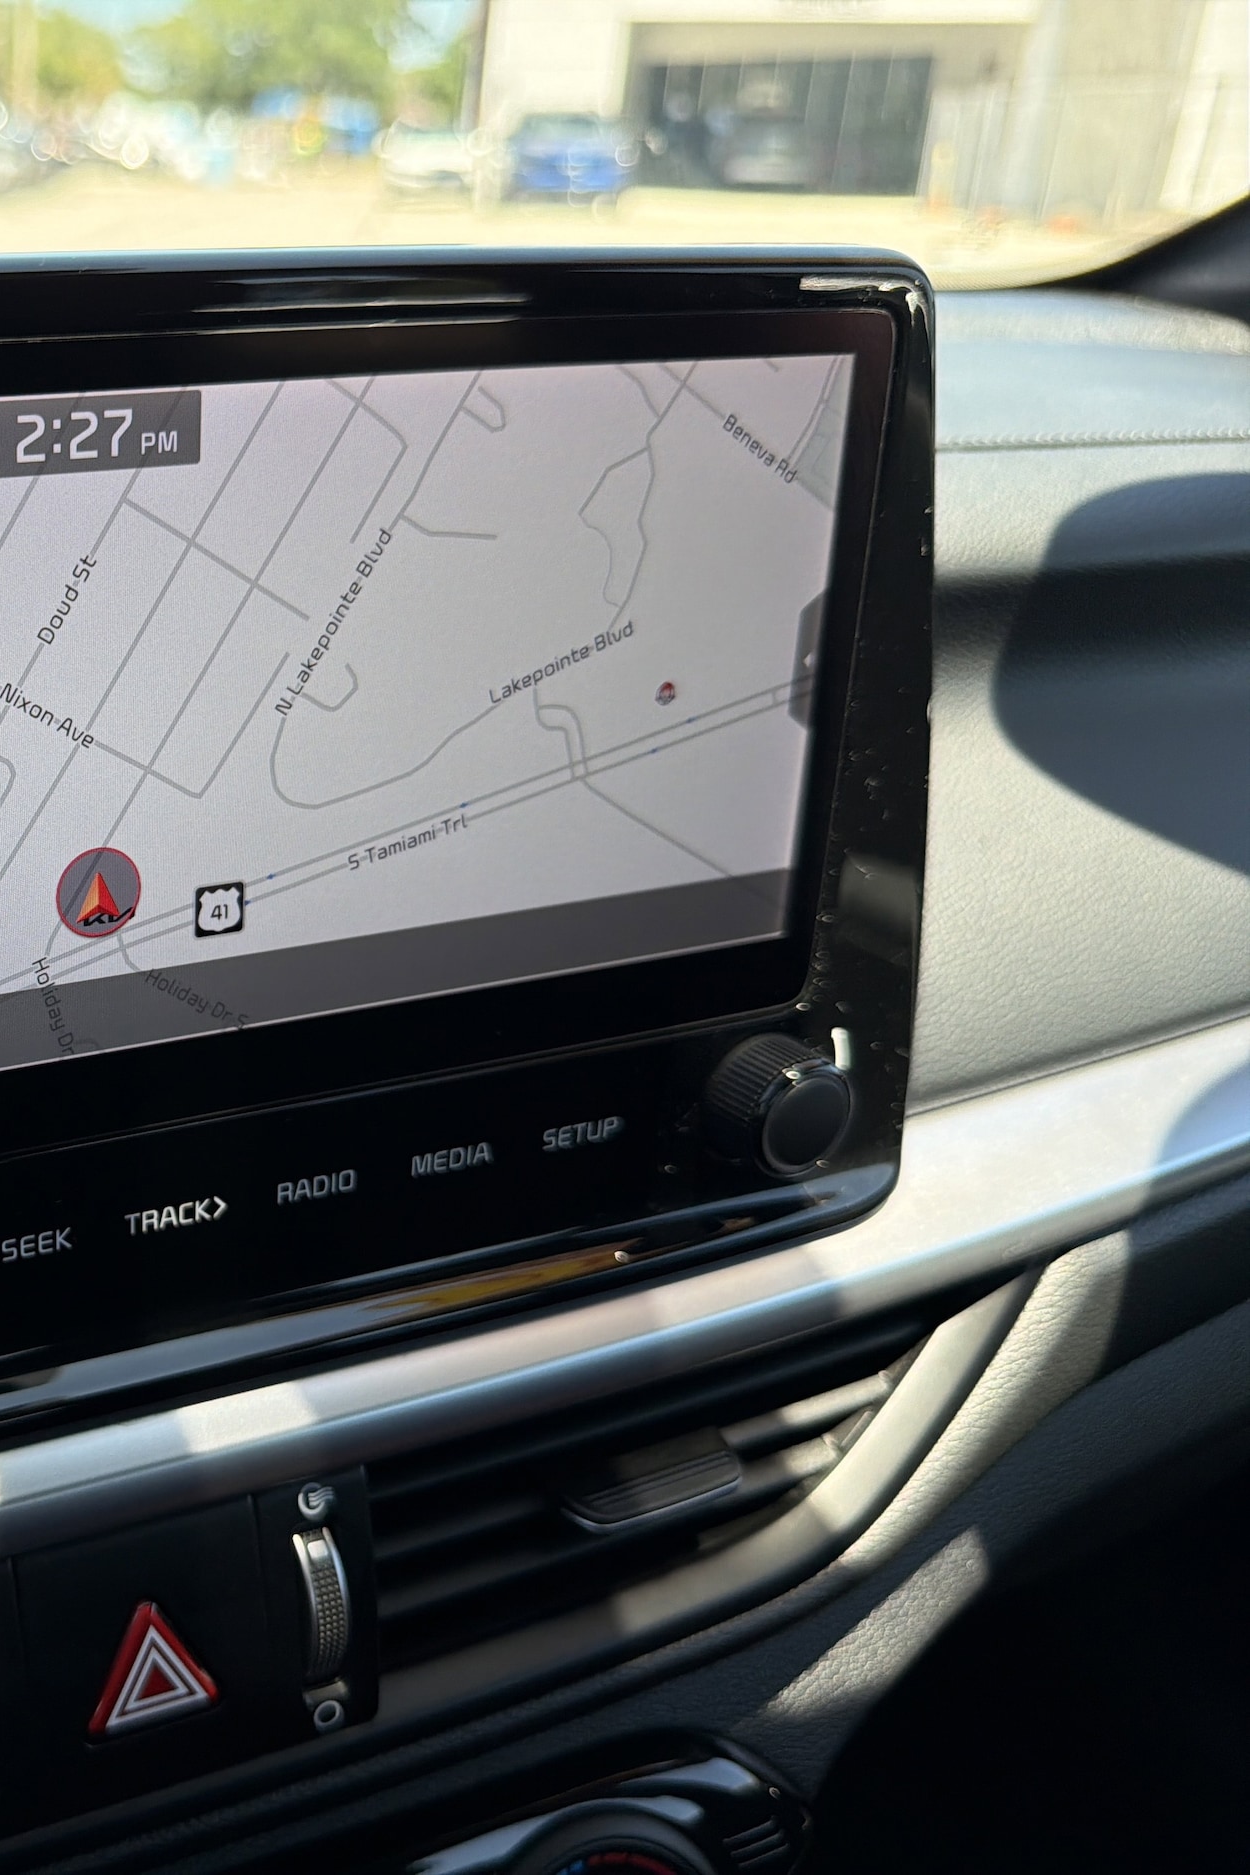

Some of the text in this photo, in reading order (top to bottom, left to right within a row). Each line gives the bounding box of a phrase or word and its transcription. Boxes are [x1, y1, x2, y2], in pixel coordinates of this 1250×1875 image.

[16, 409, 178, 464] 2:27 PM
[723, 414, 798, 484] Beneva Rd
[36, 555, 97, 645] Doud St
[274, 527, 392, 716] N Lakepointe Blvd
[488, 621, 635, 704] Lakepointe Blvd
[0, 682, 95, 749] Nixon Ave
[347, 814, 469, 871] S Tamiami Trl
[210, 903, 229, 921] 41
[32, 956, 75, 1055] Holiday Dr
[145, 968, 209, 1014] Holiday
[211, 1001, 234, 1020] Dr
[410, 1142, 494, 1179] MEDIA
[543, 1115, 623, 1153] SETUP
[276, 1169, 357, 1205] RADIO
